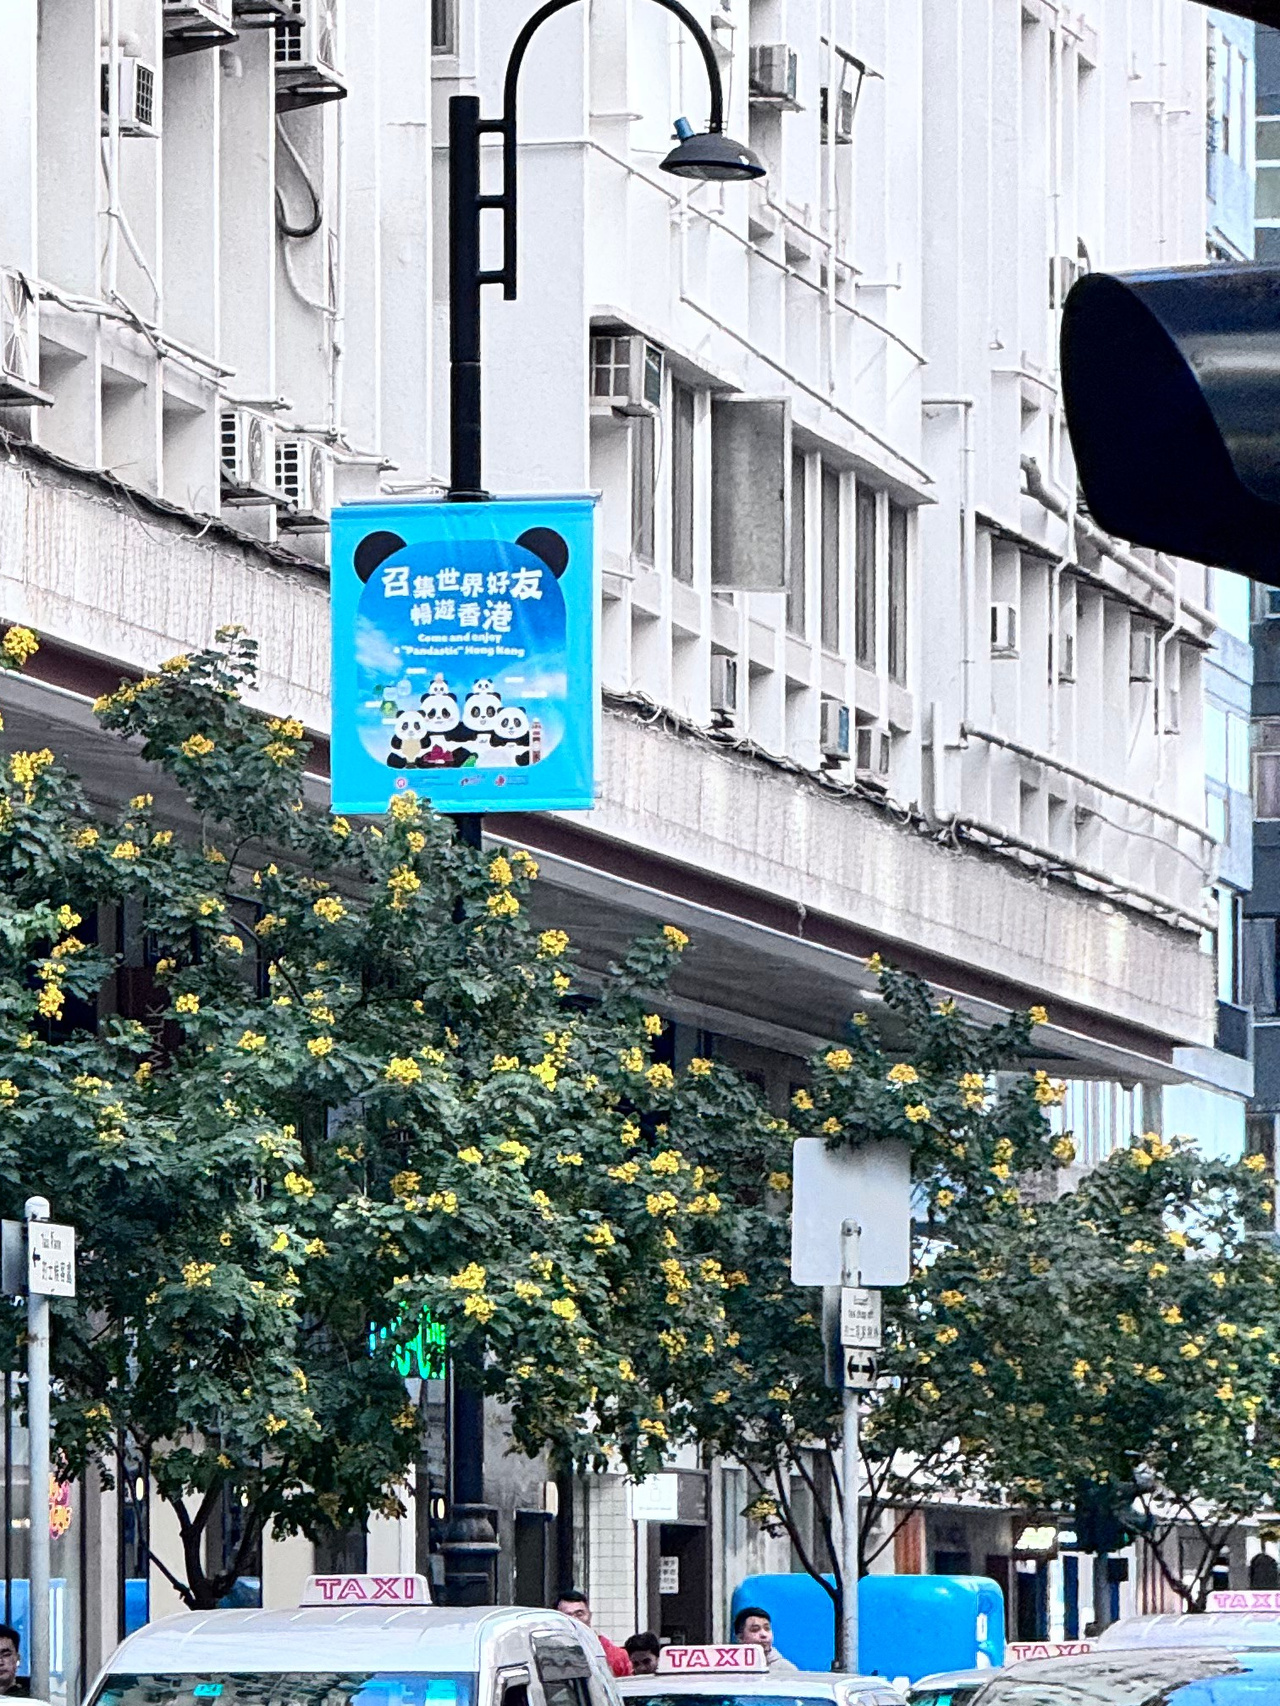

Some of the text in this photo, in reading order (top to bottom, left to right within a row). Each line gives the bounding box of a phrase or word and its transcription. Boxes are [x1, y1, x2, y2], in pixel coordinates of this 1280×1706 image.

[381, 566, 543, 600] 召集世界好友
[410, 598, 513, 632] 暢遊香港
[418, 632, 502, 644] Come and enjoy
[464, 645, 495, 656] Hong
[496, 645, 525, 658] Kong
[315, 1577, 415, 1600] TAXI
[666, 1648, 755, 1668] TAXI
